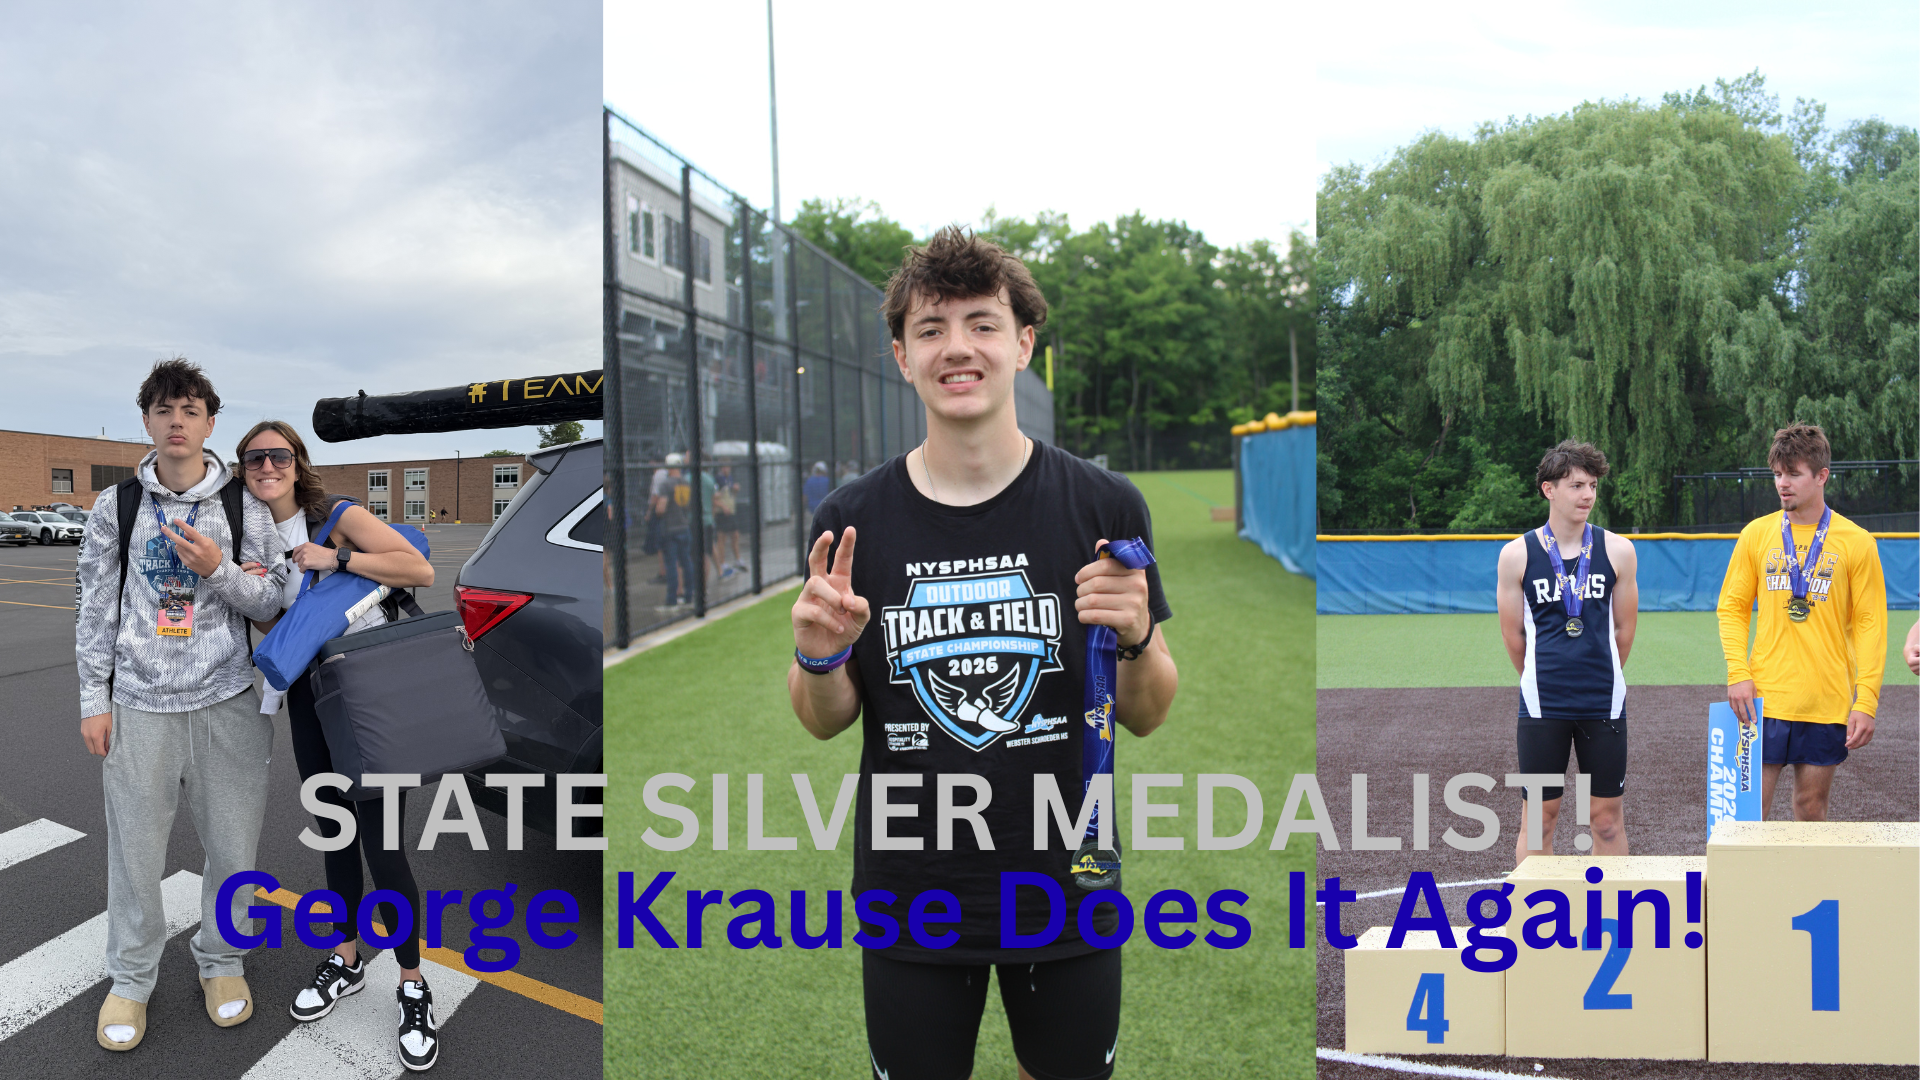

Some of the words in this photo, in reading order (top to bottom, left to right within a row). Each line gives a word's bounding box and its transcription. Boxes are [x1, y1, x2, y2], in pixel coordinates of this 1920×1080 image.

[139, 559, 171, 573] TRACK
[906, 553, 1029, 576] NYSPHSAA
[926, 579, 1011, 604] OUTDOOR
[885, 607, 966, 650] TRACK
[970, 612, 985, 630] &
[989, 598, 1057, 637] FIELD
[906, 645, 944, 663] STATE
[946, 639, 1039, 653] CHAMPIONSHIP
[809, 659, 829, 667] ICAC
[948, 655, 999, 676] 2026
[1095, 675, 1106, 730] NYSPHSAA
[884, 722, 919, 733] PRESENTED
[920, 722, 930, 732] BY
[1031, 716, 1068, 729] NYSPHSAA
[1006, 738, 1031, 748] WEBSTER
[1031, 733, 1060, 744] SCHROEDER
[1060, 732, 1068, 740] HS
[1582, 918, 1632, 1010] 2
[1792, 900, 1840, 1011] 1
[1406, 973, 1449, 1044] 4
